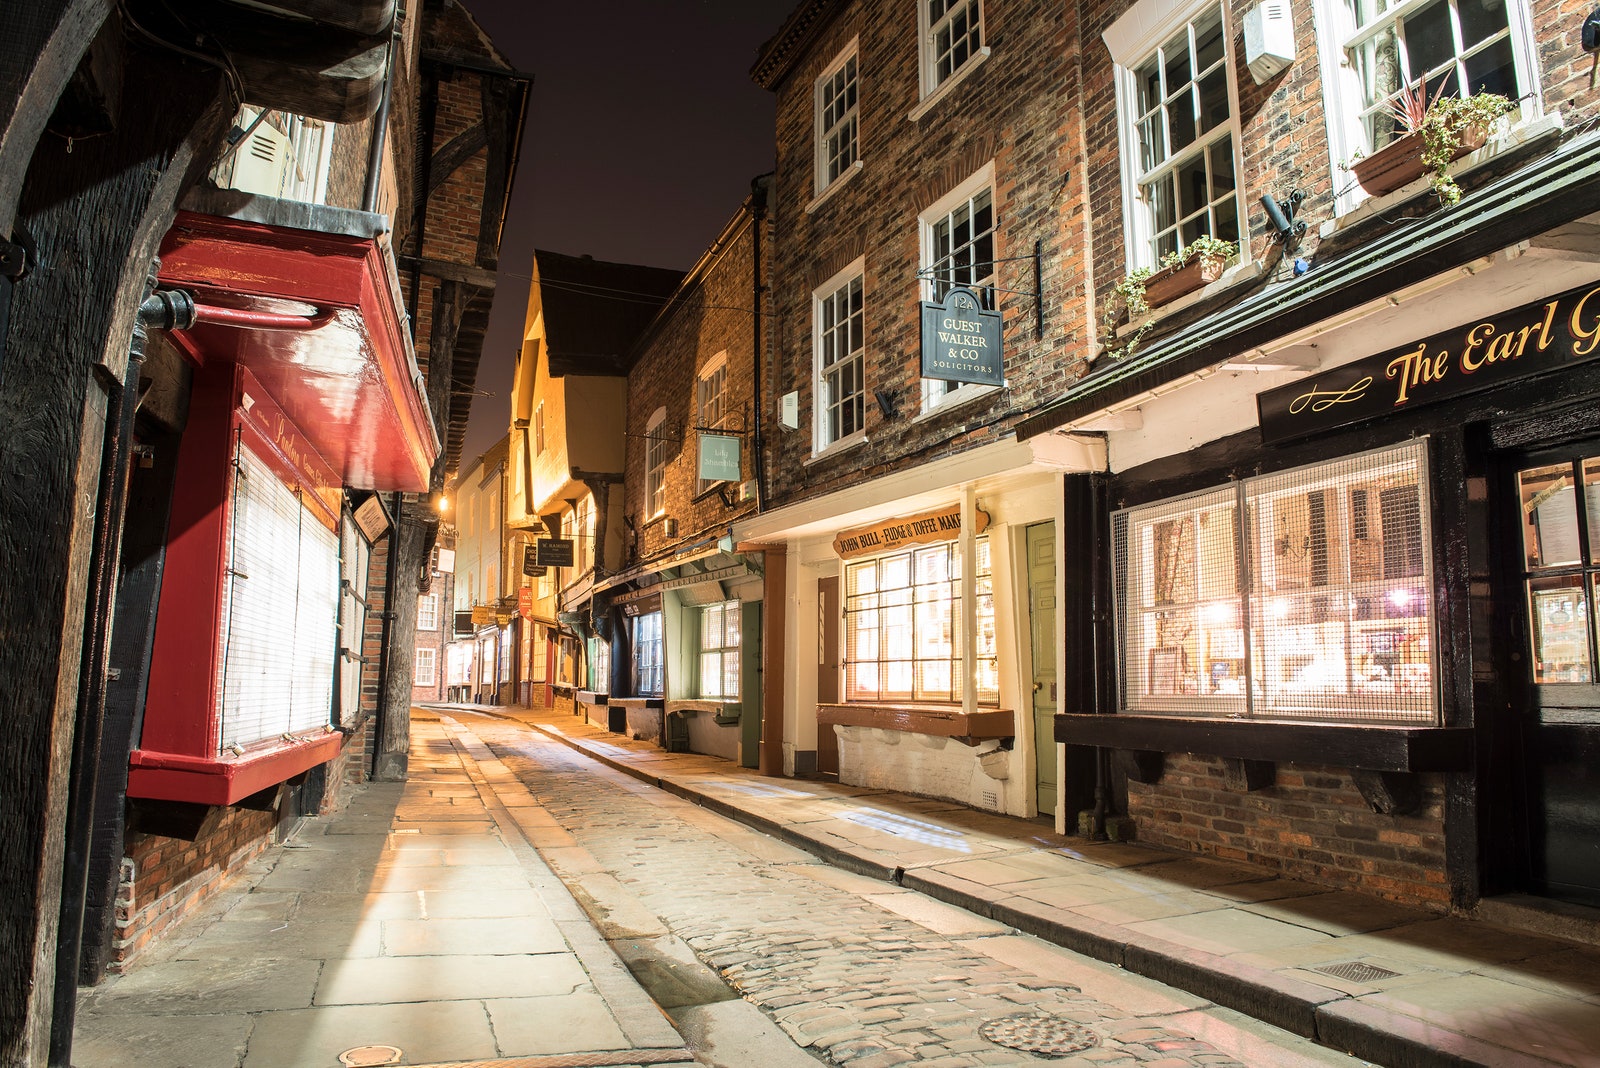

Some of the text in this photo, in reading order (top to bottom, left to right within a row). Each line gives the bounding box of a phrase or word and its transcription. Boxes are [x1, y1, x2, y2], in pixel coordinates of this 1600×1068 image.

[953, 295, 974, 310] 12A
[943, 318, 983, 334] GUEST
[938, 331, 988, 348] WALKER
[1386, 286, 1600, 405] The Earl G
[948, 347, 979, 361] & CO
[933, 360, 991, 373] SOLICITORS
[840, 536, 859, 554] JOHN
[859, 531, 882, 549] BULL
[885, 525, 907, 542] FUDGE
[912, 518, 937, 535] TOFFEE
[939, 513, 961, 530] MAKE
